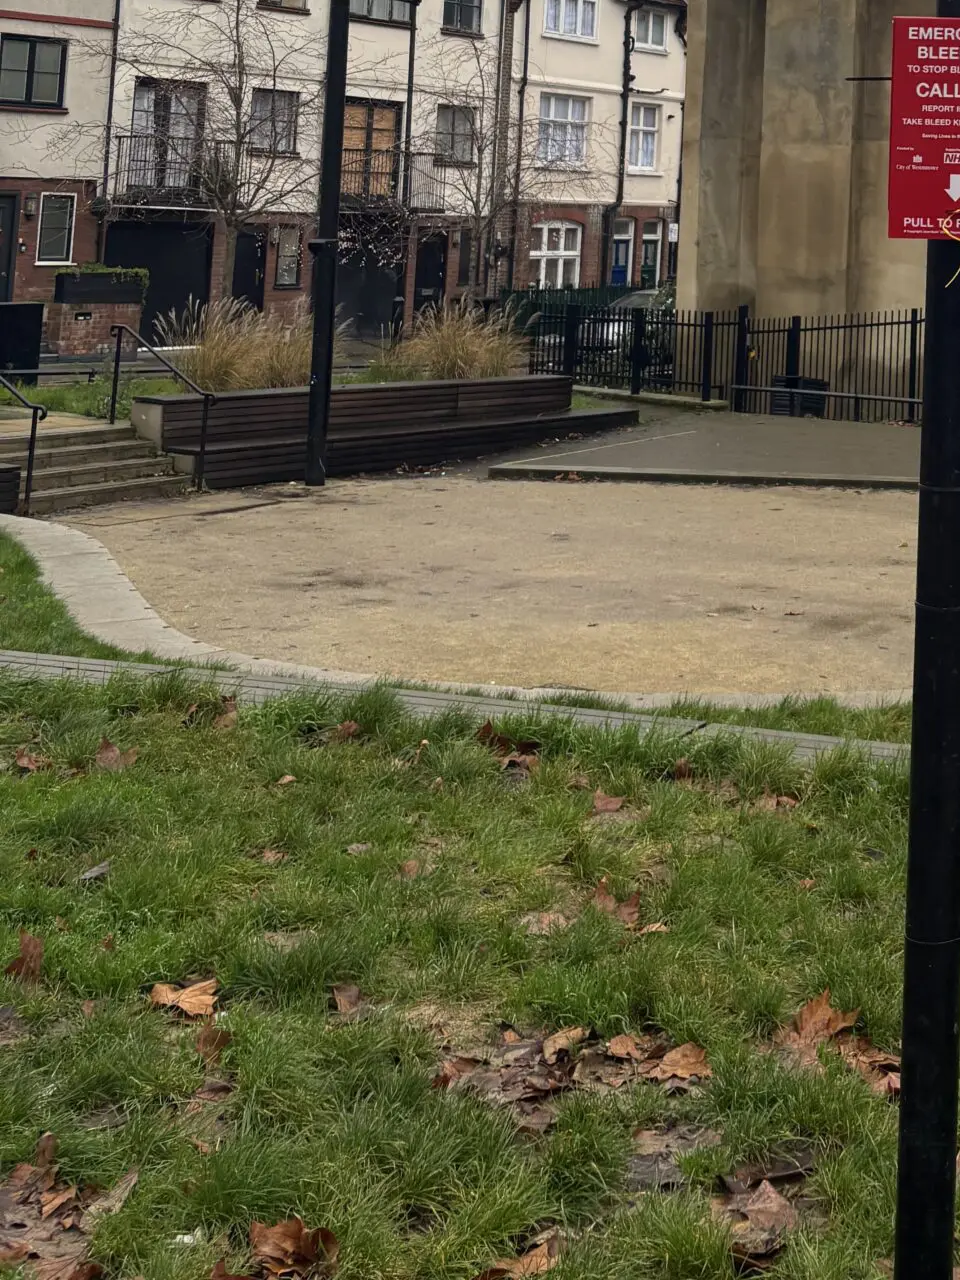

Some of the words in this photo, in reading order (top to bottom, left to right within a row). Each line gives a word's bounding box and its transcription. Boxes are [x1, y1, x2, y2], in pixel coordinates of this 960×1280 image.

[907, 64, 920, 73] TO
[922, 65, 948, 74] STOP
[922, 105, 955, 113] REPORT
[902, 118, 922, 126] TAKE
[925, 118, 951, 126] BLEED
[903, 217, 934, 228] PULL
[936, 218, 953, 228] TO
